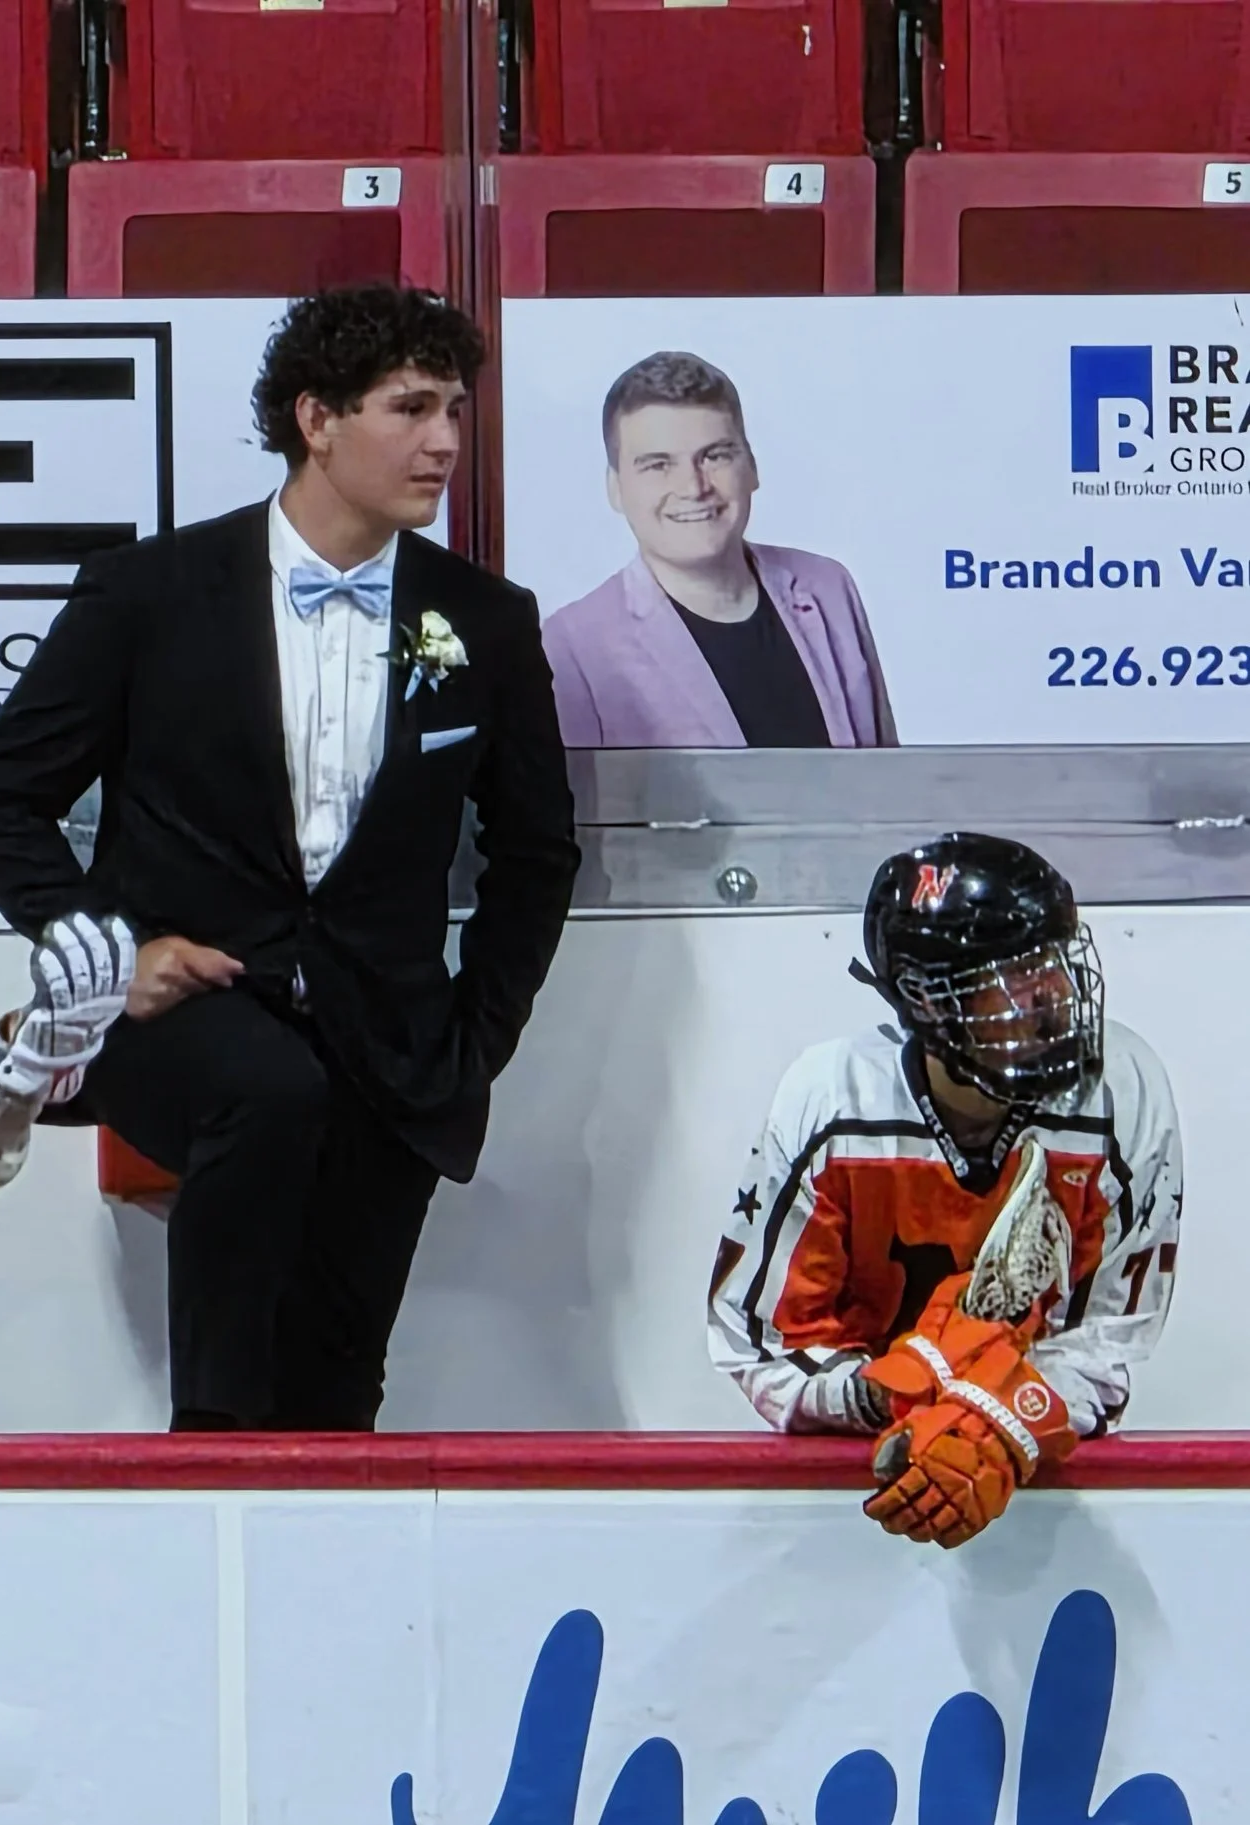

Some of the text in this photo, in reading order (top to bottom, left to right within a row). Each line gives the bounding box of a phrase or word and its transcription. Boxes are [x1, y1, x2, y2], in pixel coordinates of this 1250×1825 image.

[363, 175, 380, 199] 3
[786, 172, 803, 196] 4
[1224, 172, 1242, 195] 5
[1169, 345, 1250, 384] BR
[1170, 446, 1245, 473] GRO
[1072, 480, 1110, 496] Real
[1177, 480, 1243, 496] Ontario
[945, 546, 1250, 589] Brandon Va
[1048, 646, 1250, 687] 226.923
